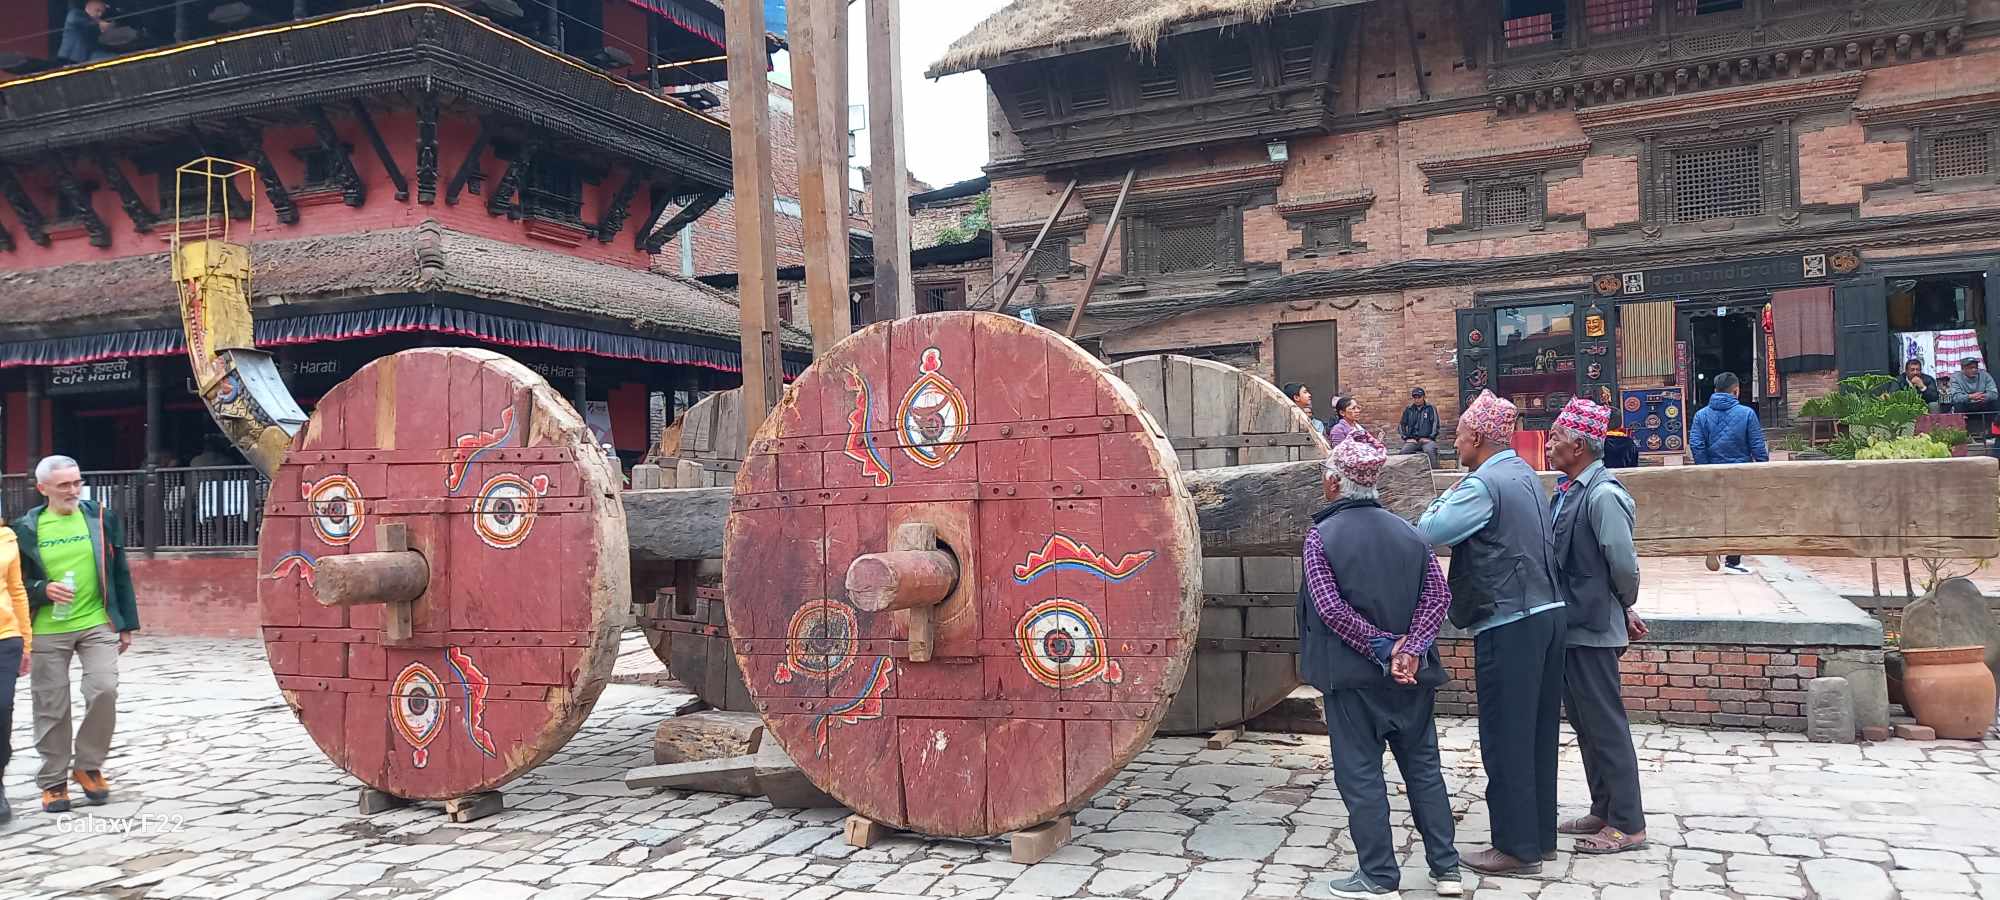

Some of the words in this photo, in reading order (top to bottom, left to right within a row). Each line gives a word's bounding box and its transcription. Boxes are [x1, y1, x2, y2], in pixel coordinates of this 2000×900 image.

[300, 360, 337, 374] Harati
[550, 364, 574, 377] Hara
[88, 371, 132, 382] Harati
